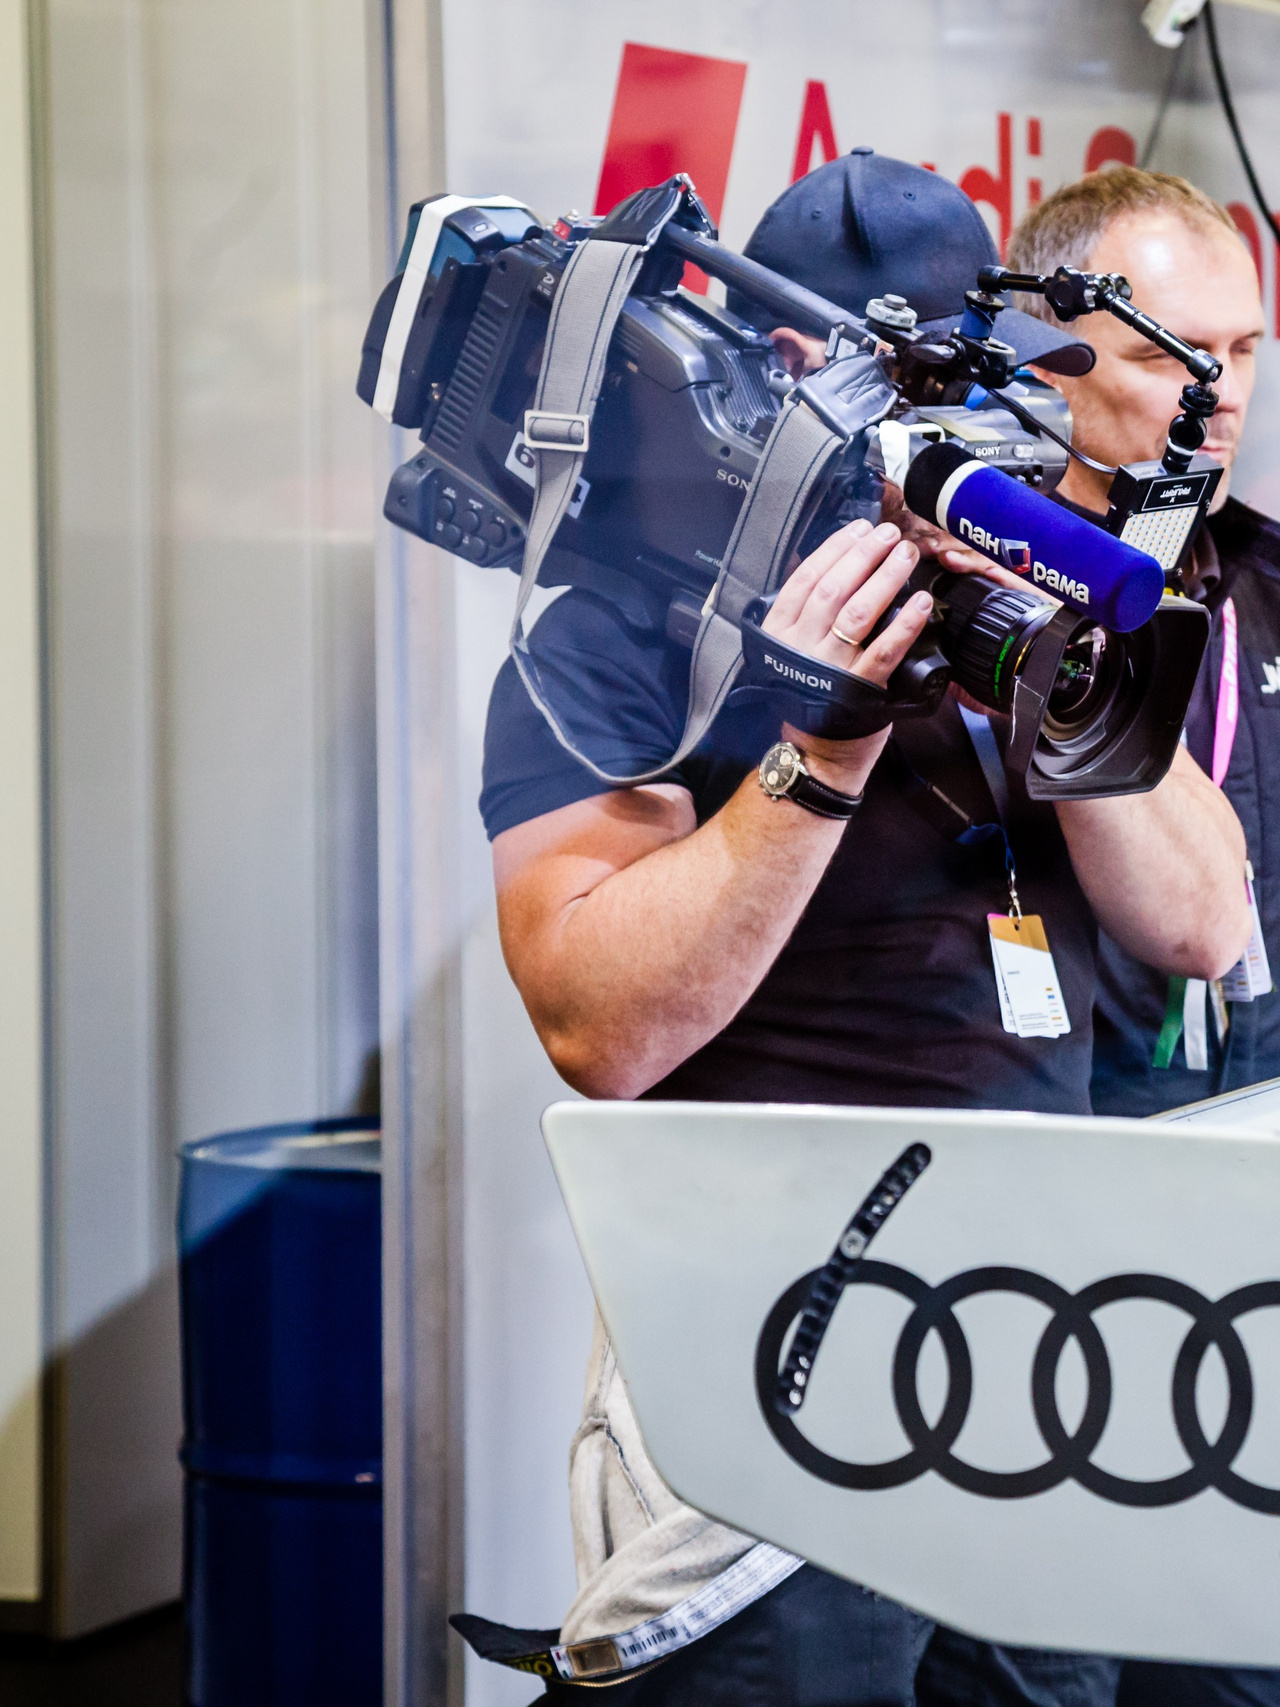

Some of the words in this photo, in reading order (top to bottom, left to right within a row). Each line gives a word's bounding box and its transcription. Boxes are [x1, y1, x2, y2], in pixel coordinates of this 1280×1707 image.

[974, 446, 1001, 457] SONY
[716, 469, 751, 492] SON
[763, 654, 832, 692] FUJINON
